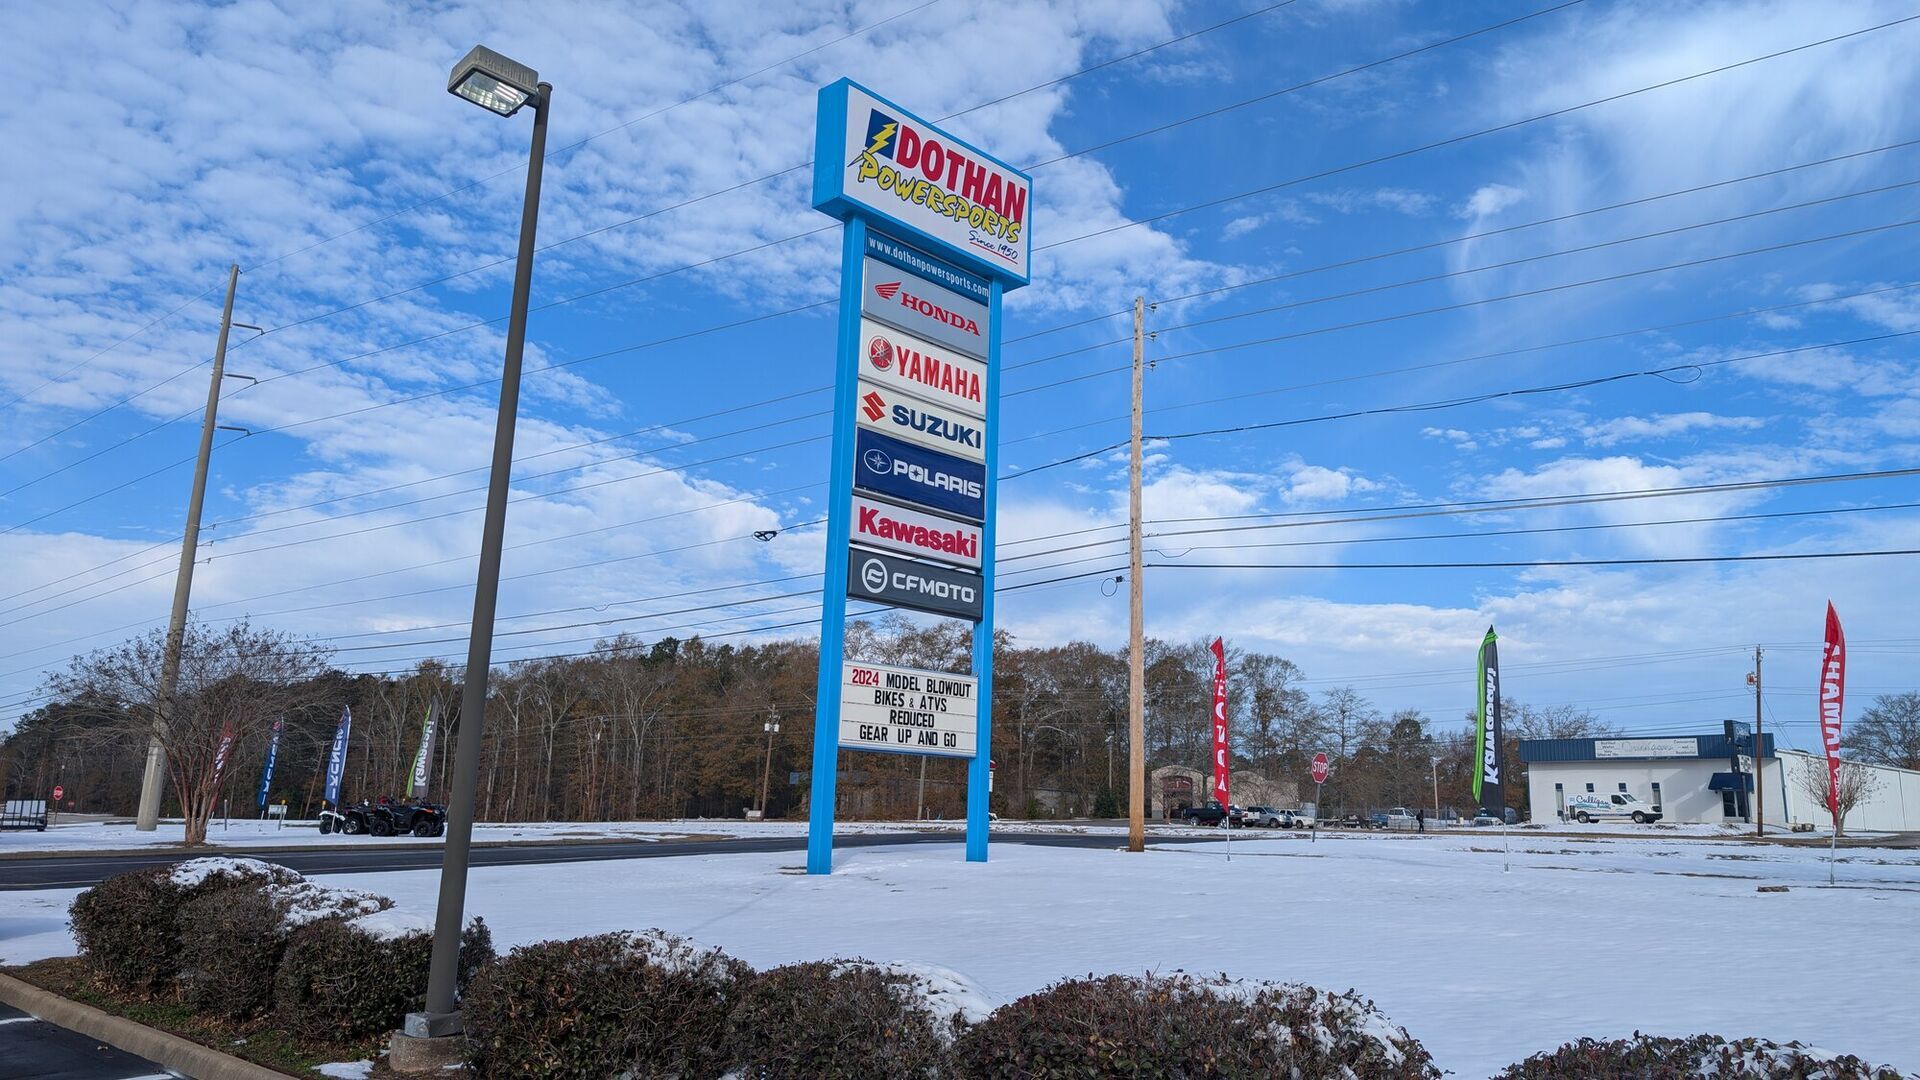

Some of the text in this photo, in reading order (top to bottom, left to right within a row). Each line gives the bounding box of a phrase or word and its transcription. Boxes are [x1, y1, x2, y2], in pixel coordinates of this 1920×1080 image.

[896, 124, 1026, 223] DOTHAN
[858, 150, 1022, 244] POWERSPORTS
[968, 230, 1019, 260] Since 1950
[868, 236, 989, 298] www.dothanpowersports.com
[901, 291, 981, 336] HONDA
[896, 345, 981, 403] YAMAHA
[892, 404, 982, 450] SUZUKI
[893, 458, 982, 499] POLARIS
[858, 506, 977, 558] Kawasaki
[892, 570, 976, 604] CFMOTO
[851, 668, 972, 698] 2024 MODEL BLOWOUT
[874, 690, 947, 712] BIKES & ATVS
[859, 724, 957, 747] GEAR UP AND GO
[889, 709, 935, 728] REDUCED
[1312, 760, 1328, 774] STOP
